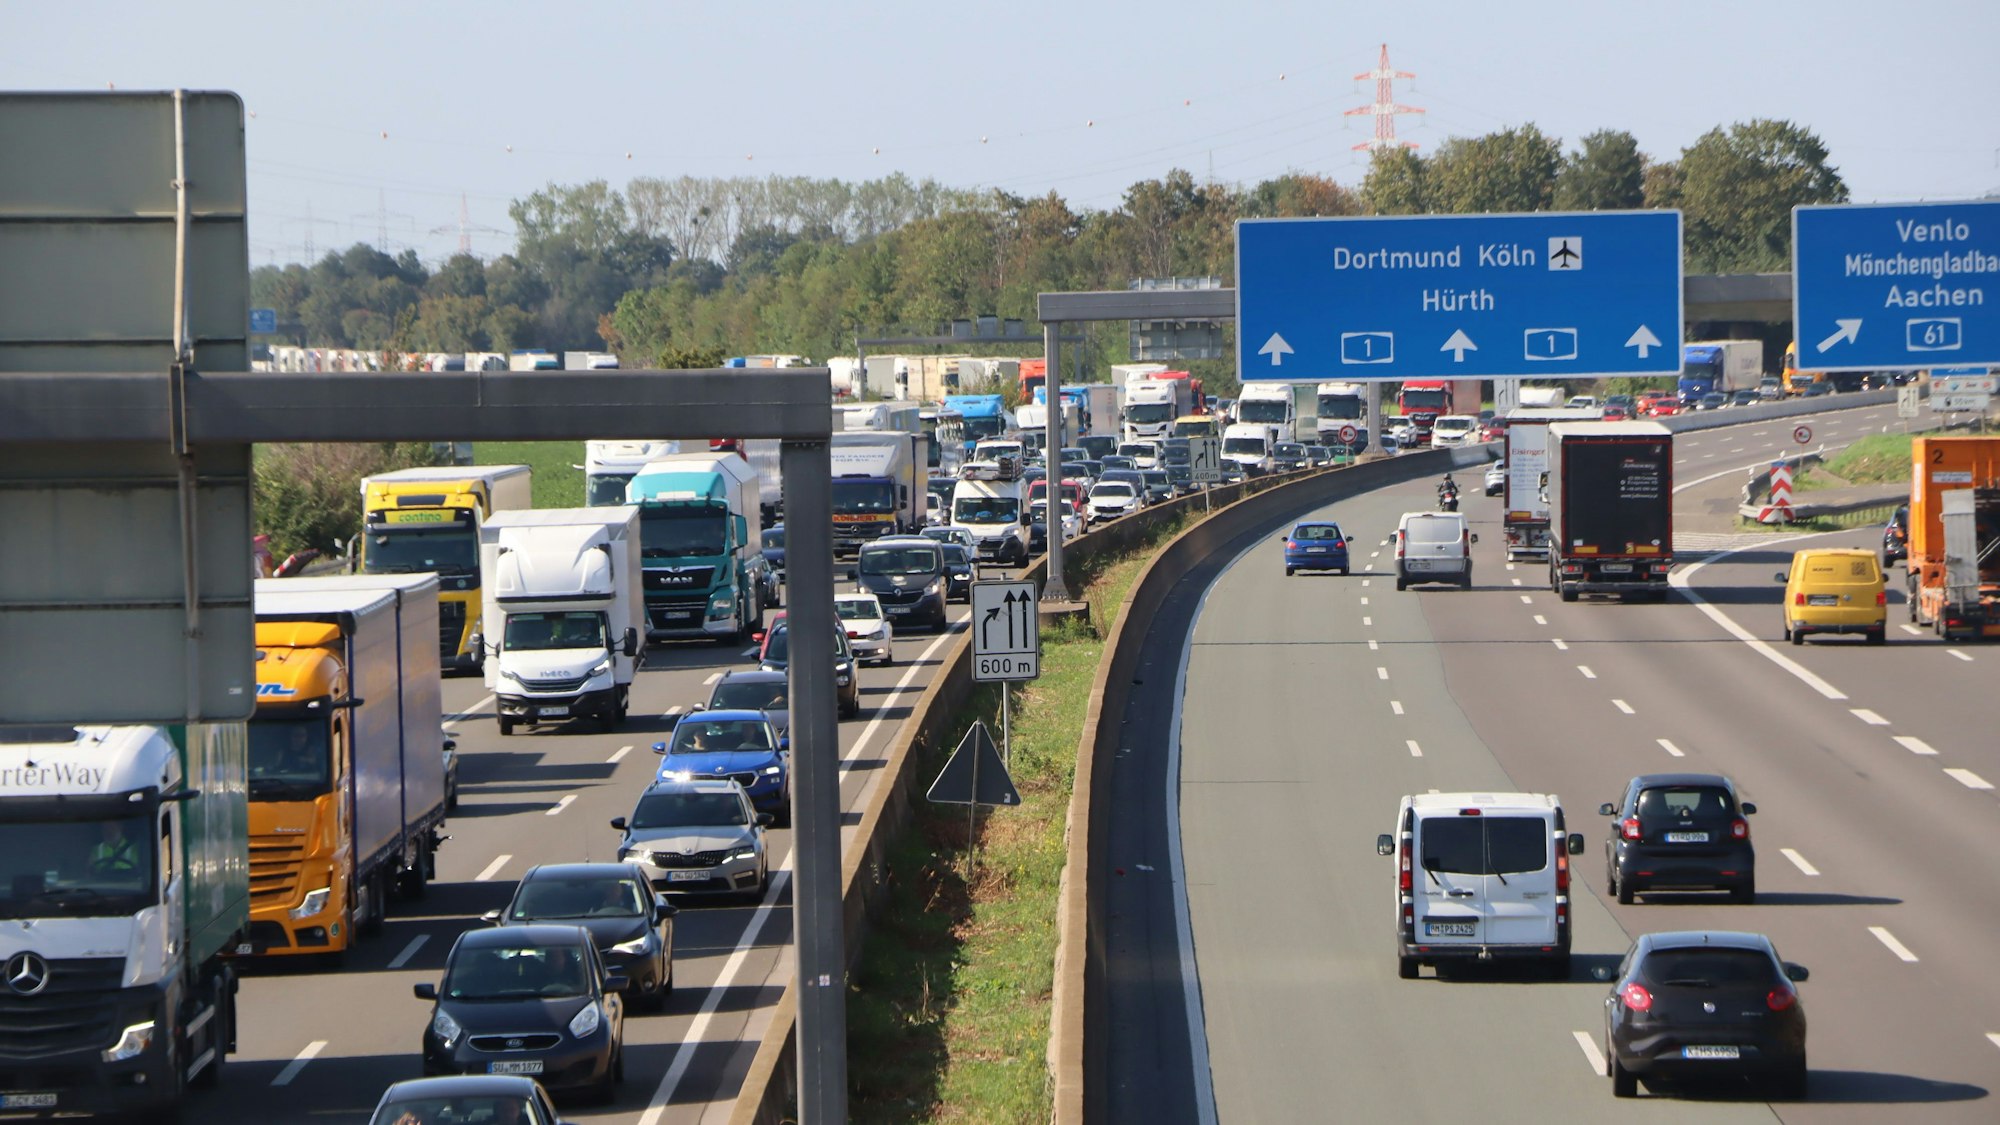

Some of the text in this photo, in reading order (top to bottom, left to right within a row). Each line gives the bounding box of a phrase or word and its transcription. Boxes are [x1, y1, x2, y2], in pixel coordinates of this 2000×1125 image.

[1895, 217, 1970, 243] Venlo
[1333, 243, 1536, 270] Dortmund Köln
[1845, 249, 2000, 280] Mönchengladba
[1422, 288, 1495, 312] Hürth
[1884, 283, 1984, 309] Aachen
[1547, 333, 1556, 354] 1
[1923, 323, 1945, 345] 61
[1363, 338, 1372, 358] 1
[1932, 448, 1944, 465] 2
[660, 576, 693, 584] MAN
[981, 658, 1031, 674] 600 m
[1, 761, 106, 792] rterWay
[1445, 923, 1454, 934] PS
[1455, 923, 1474, 934] 2425
[493, 1060, 542, 1073] SU MM 1877
